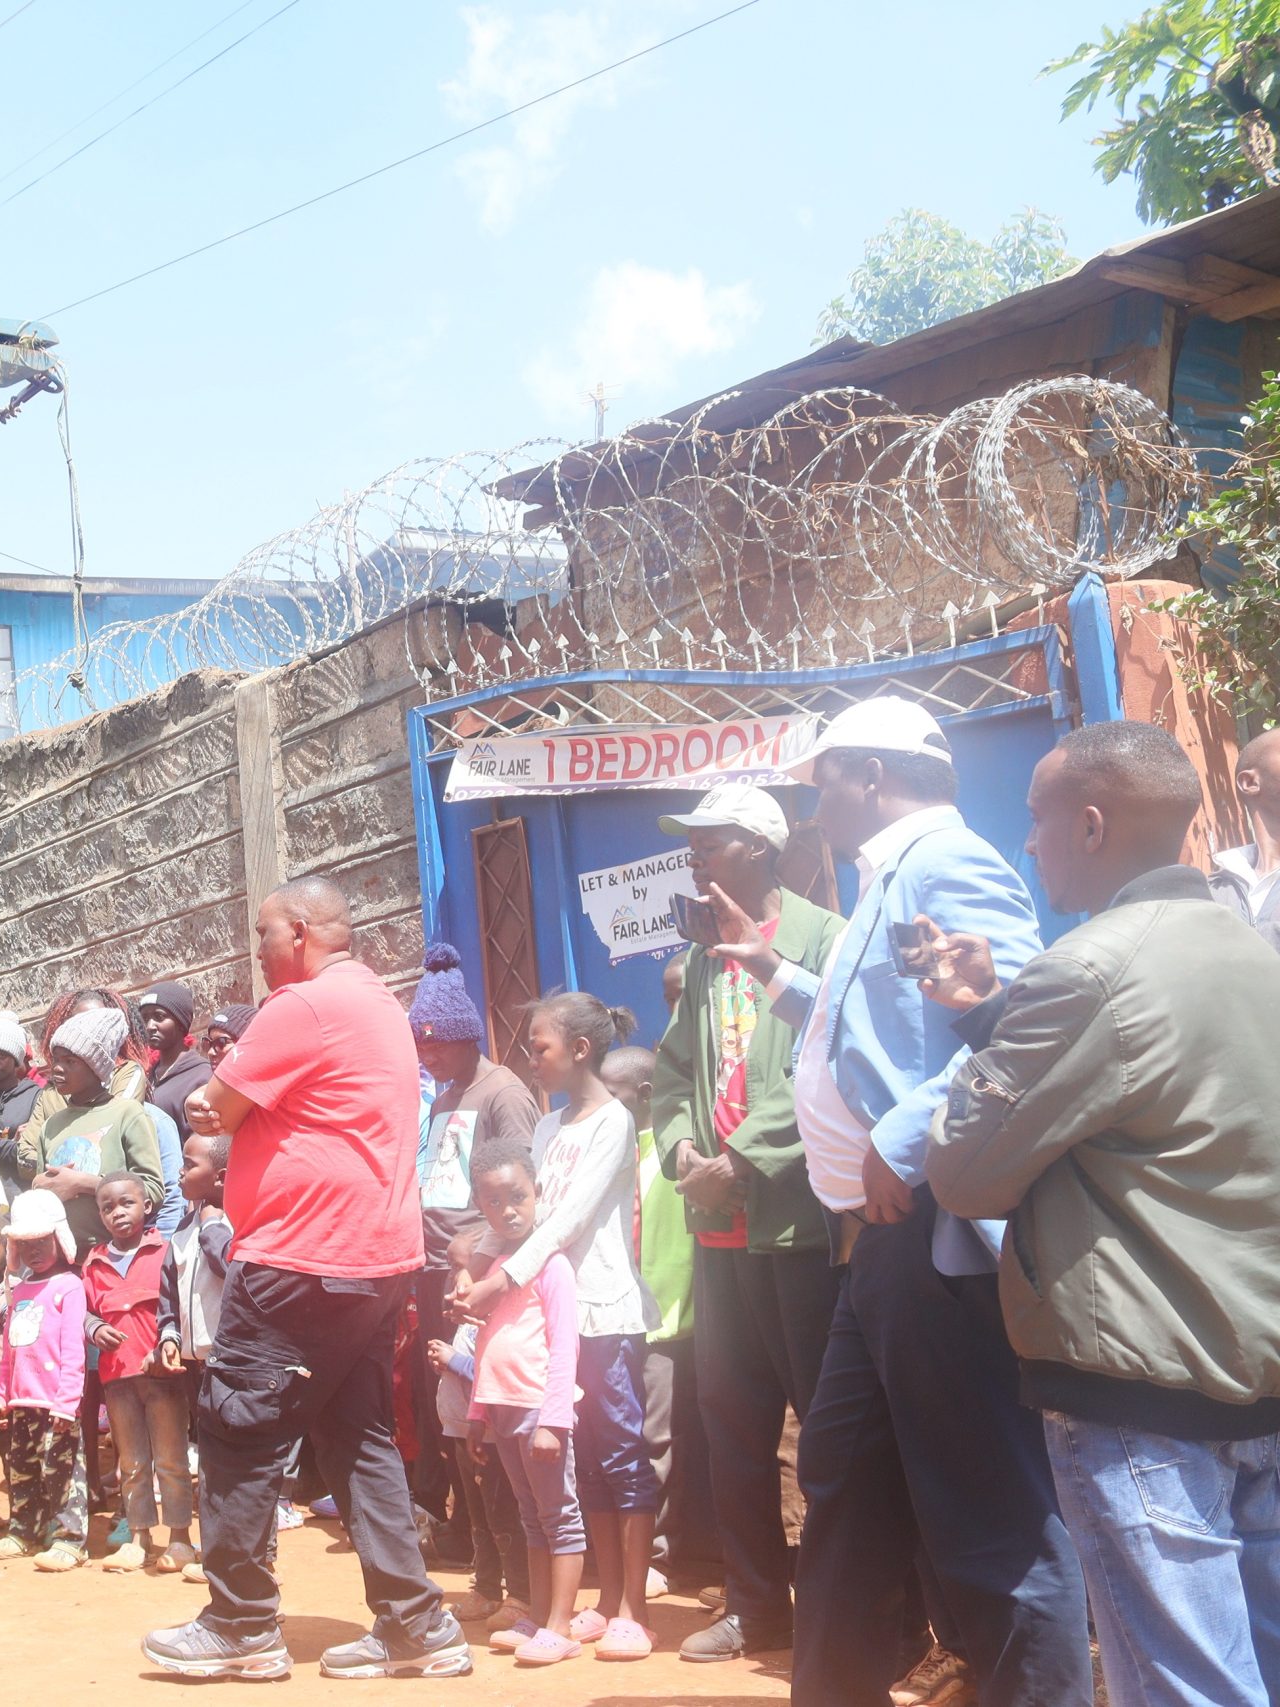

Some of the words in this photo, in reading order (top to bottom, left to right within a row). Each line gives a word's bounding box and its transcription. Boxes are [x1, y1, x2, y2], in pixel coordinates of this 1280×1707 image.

[542, 739, 556, 783] 1
[568, 721, 790, 782] BEDROOM
[468, 760, 495, 777] FAIR
[499, 758, 531, 776] LANE
[580, 875, 603, 893] LET
[608, 873, 618, 887] &
[631, 885, 648, 902] by
[612, 921, 640, 942] FAIR
[642, 913, 675, 935] LANE
